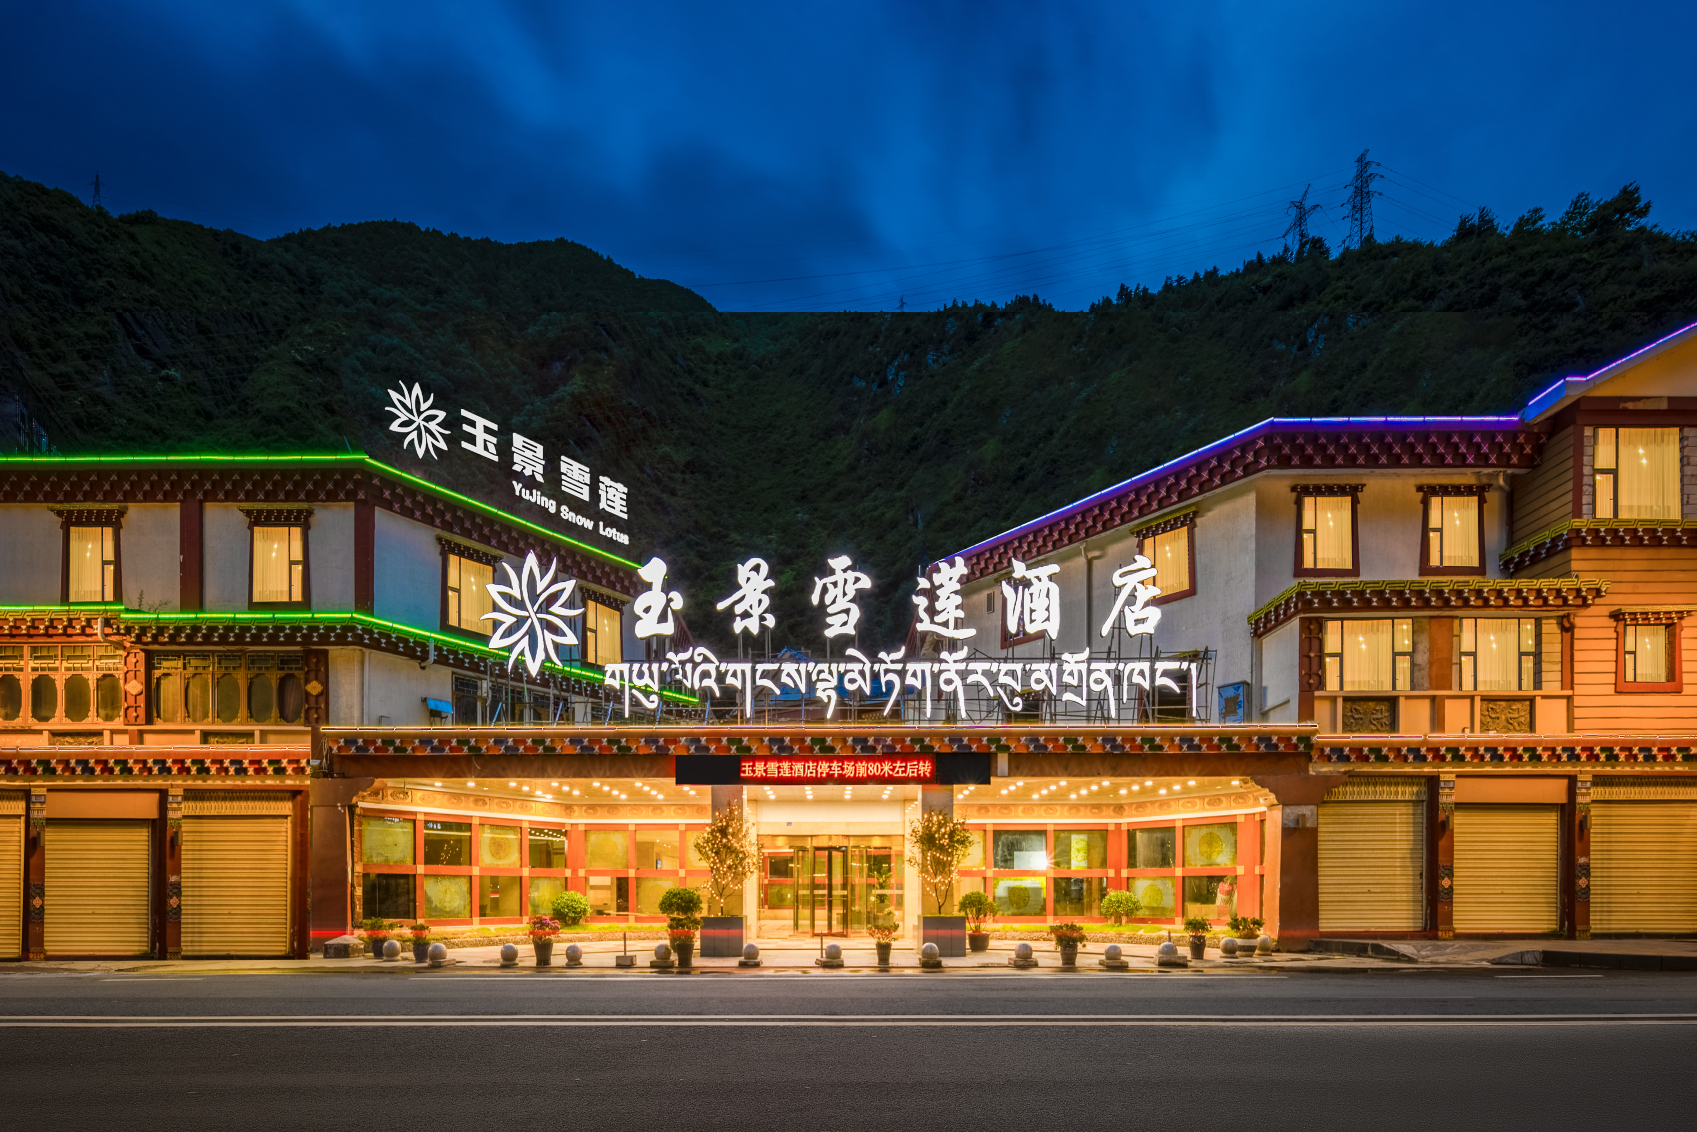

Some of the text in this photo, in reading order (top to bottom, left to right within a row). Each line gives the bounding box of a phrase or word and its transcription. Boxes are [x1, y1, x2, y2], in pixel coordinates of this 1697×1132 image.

[460, 408, 628, 520] 玉景雪莲
[512, 480, 630, 545] YuJing Snow Lotus
[633, 555, 1162, 640] 玉景雪莲酒店
[740, 761, 932, 778] 玉景雪莲酒店停车场前80米左后转
